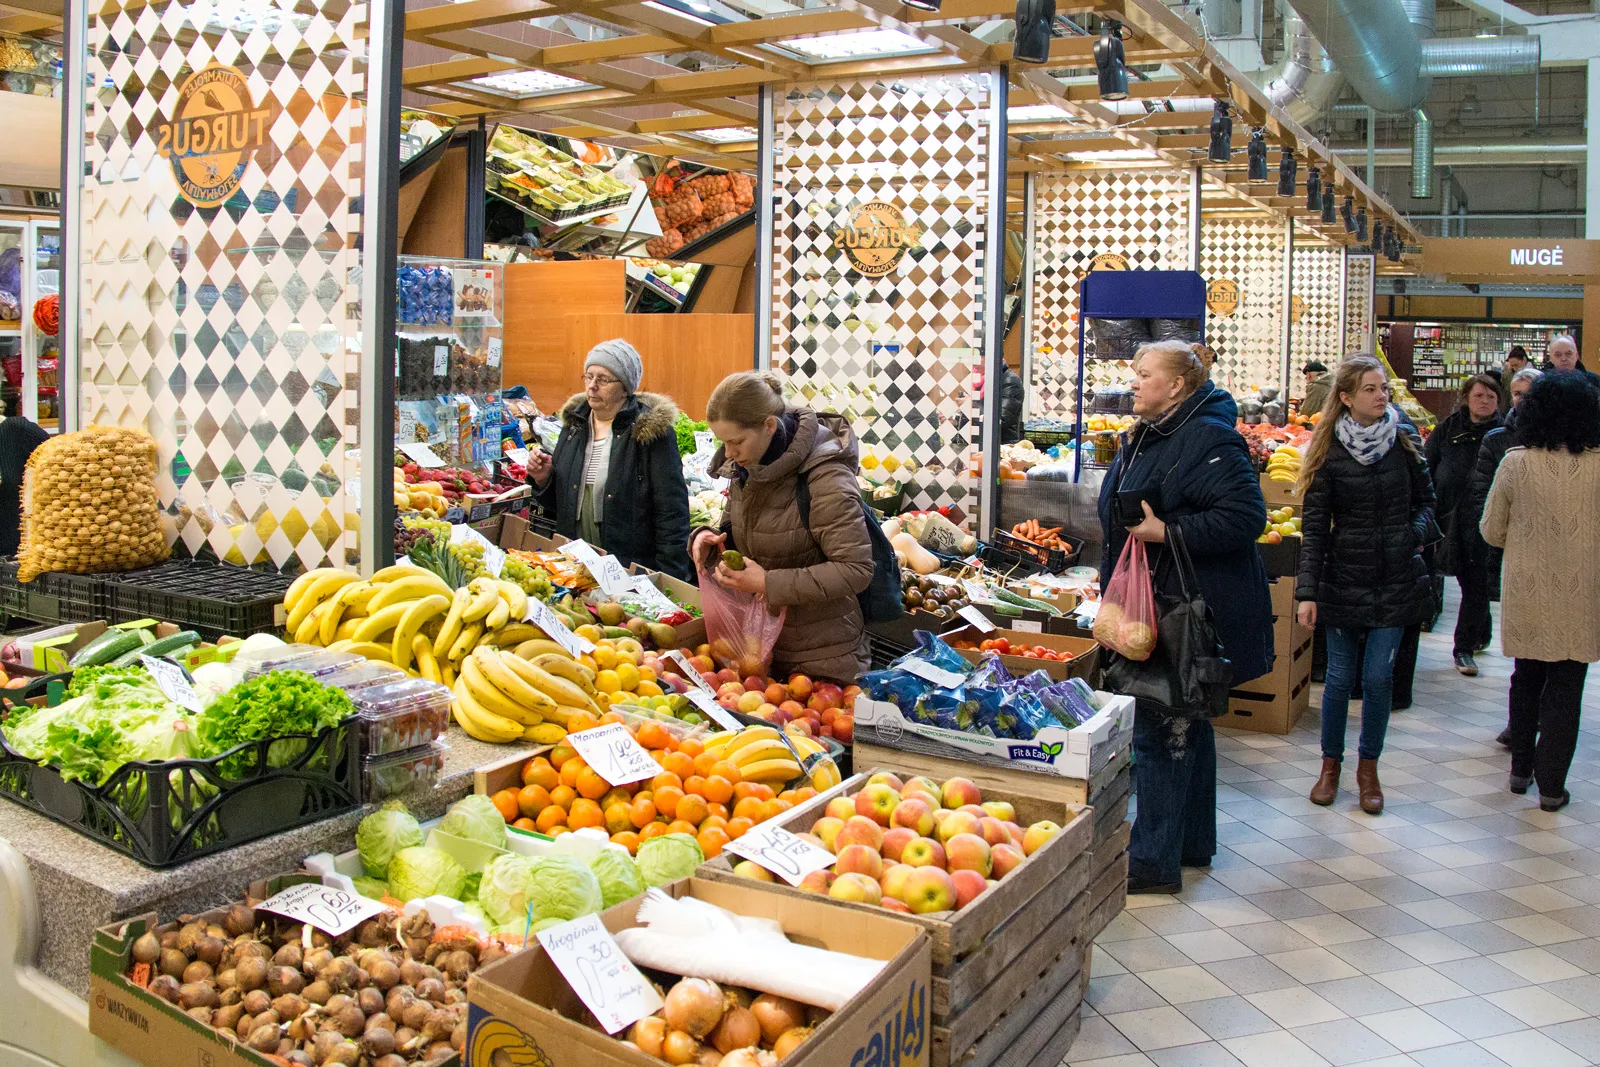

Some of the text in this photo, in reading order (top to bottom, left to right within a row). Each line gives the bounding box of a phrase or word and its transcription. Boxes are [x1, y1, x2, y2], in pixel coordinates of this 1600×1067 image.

[1510, 244, 1564, 266] MUGĖ
[1013, 748, 1024, 758] Fit
[1032, 749, 1051, 762] Easy
[321, 891, 351, 909] 60
